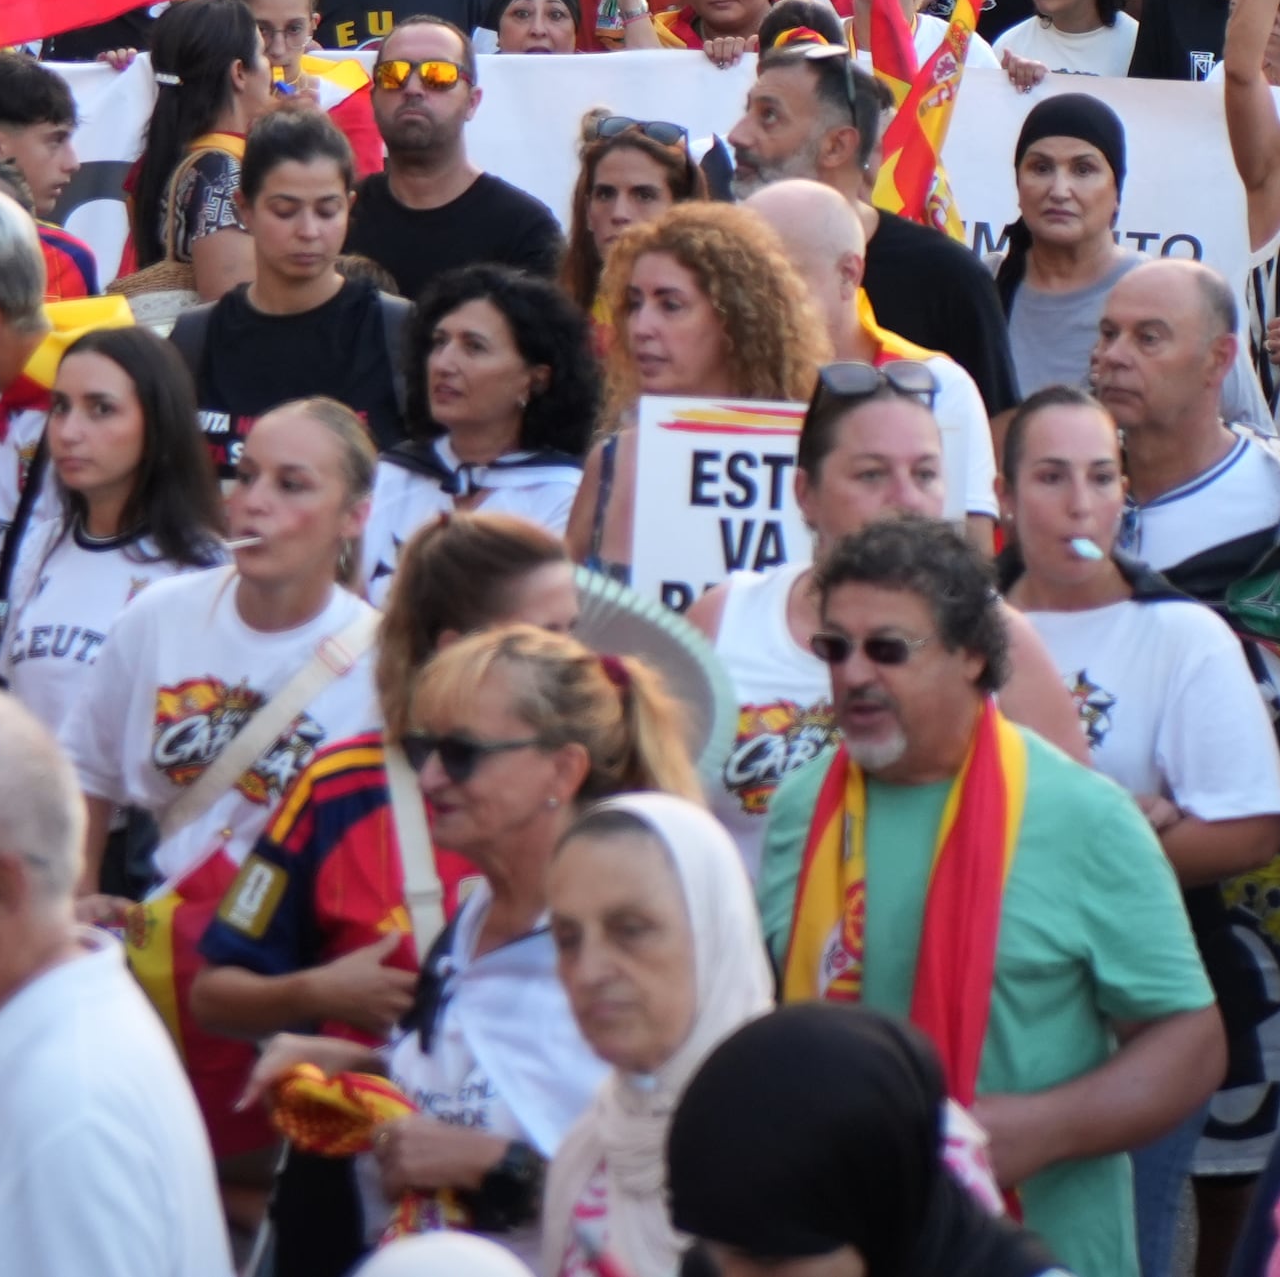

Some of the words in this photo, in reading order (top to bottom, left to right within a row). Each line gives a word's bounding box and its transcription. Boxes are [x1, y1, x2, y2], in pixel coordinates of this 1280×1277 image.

[198, 411, 231, 432] UTA
[689, 449, 794, 511] EST
[719, 517, 788, 573] VA
[9, 624, 107, 665] CEUT
